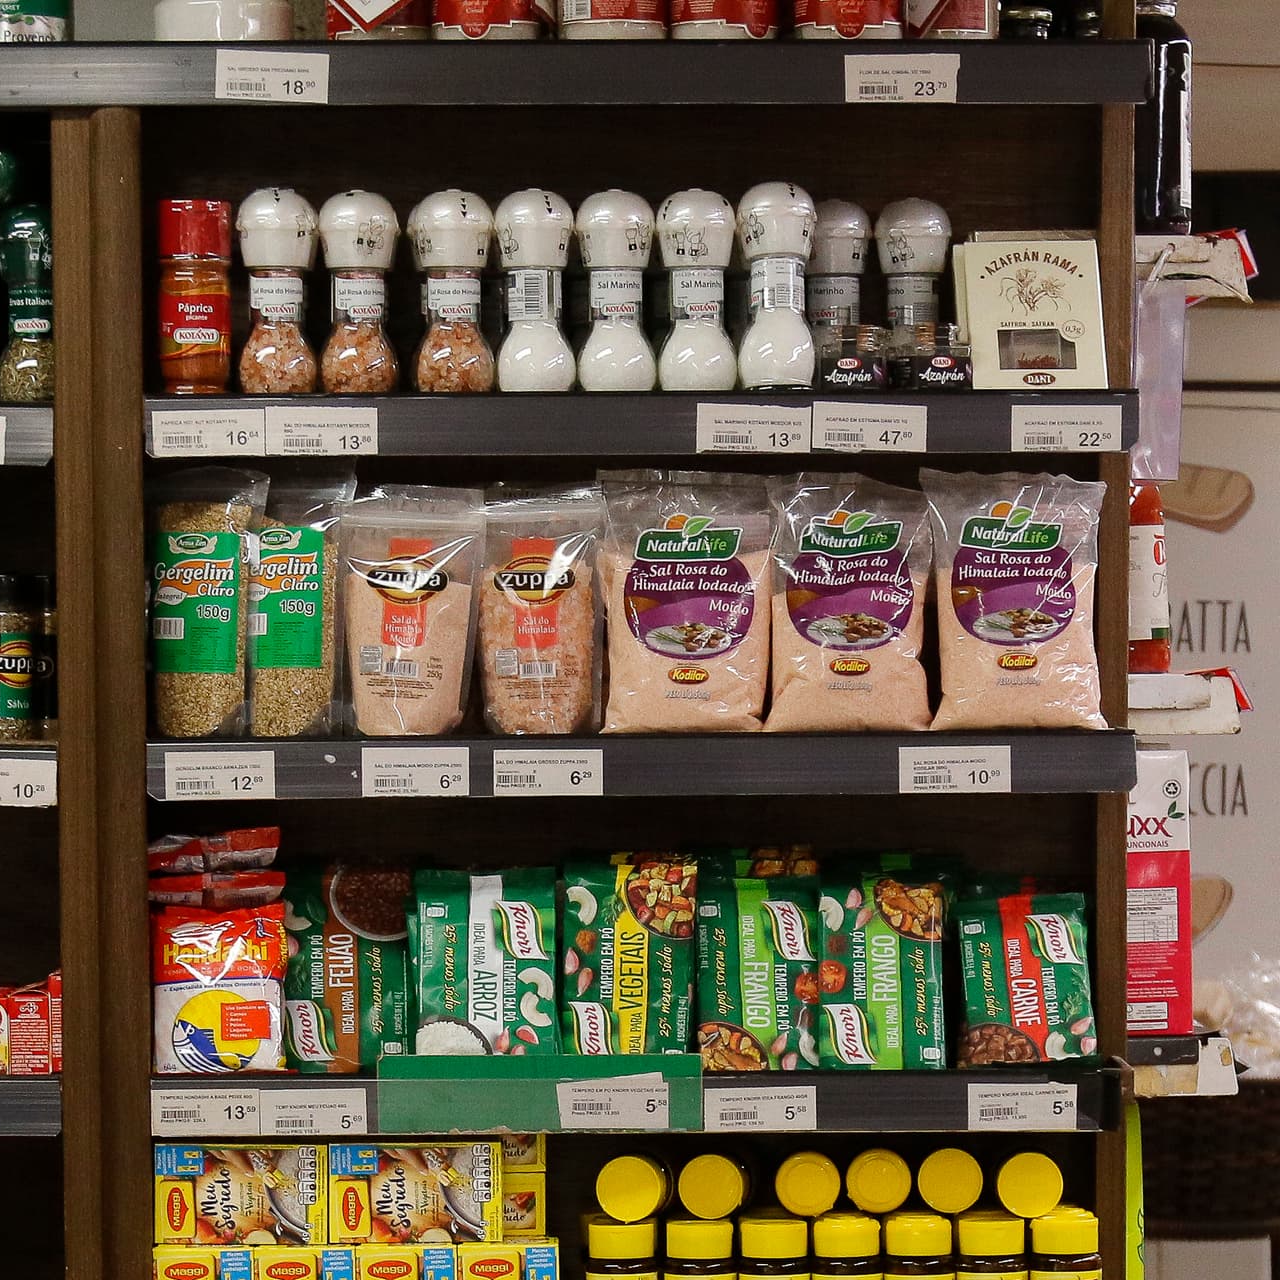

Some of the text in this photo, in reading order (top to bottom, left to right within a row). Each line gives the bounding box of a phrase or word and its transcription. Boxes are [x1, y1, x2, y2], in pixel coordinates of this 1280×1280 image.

[985, 248, 1078, 277] AZAFRÁN RAMA
[597, 281, 641, 291] Sal Marinho
[177, 302, 213, 316] Páprica
[185, 313, 208, 322] picante
[838, 358, 858, 369] DANI
[824, 367, 875, 387] Azafrán
[1025, 373, 1052, 384] DANI
[971, 524, 1049, 545] NaturalLife
[647, 535, 727, 555] NaturalLife
[975, 552, 1052, 566] Sal Rosa do
[154, 558, 235, 584] Gergelim
[649, 563, 728, 577] Sal Rosa do
[958, 565, 1068, 581] Himalaia Iodado
[374, 569, 442, 592] zuppa
[501, 569, 569, 590] zuppa
[633, 577, 746, 593] Himalaia Iodado
[196, 583, 235, 598] Claro
[196, 605, 231, 621] 150g
[279, 599, 316, 616] 150g
[709, 599, 749, 616] Moído
[391, 615, 417, 625] Sal do
[523, 617, 550, 626] Sal do
[384, 624, 423, 634] Himalaia
[517, 625, 556, 634] Himalaia
[671, 669, 707, 684] Kodilar
[440, 773, 462, 789] 6,29
[968, 769, 1001, 785] 10,99
[510, 905, 532, 958] Knorr
[775, 906, 800, 960] Knorr
[1041, 916, 1067, 962] Knorr
[163, 943, 268, 965] Hondashi
[328, 933, 355, 990] FEIJÃO
[310, 935, 323, 1001] TEMPERO EM PÓ
[619, 930, 645, 1011] VEGETAIS
[472, 969, 498, 1022] ARROZ
[743, 960, 771, 1029] FRANGO
[1012, 977, 1039, 1028] CARNE
[300, 1002, 322, 1059] Knorr
[170, 1265, 209, 1280] Maggi
